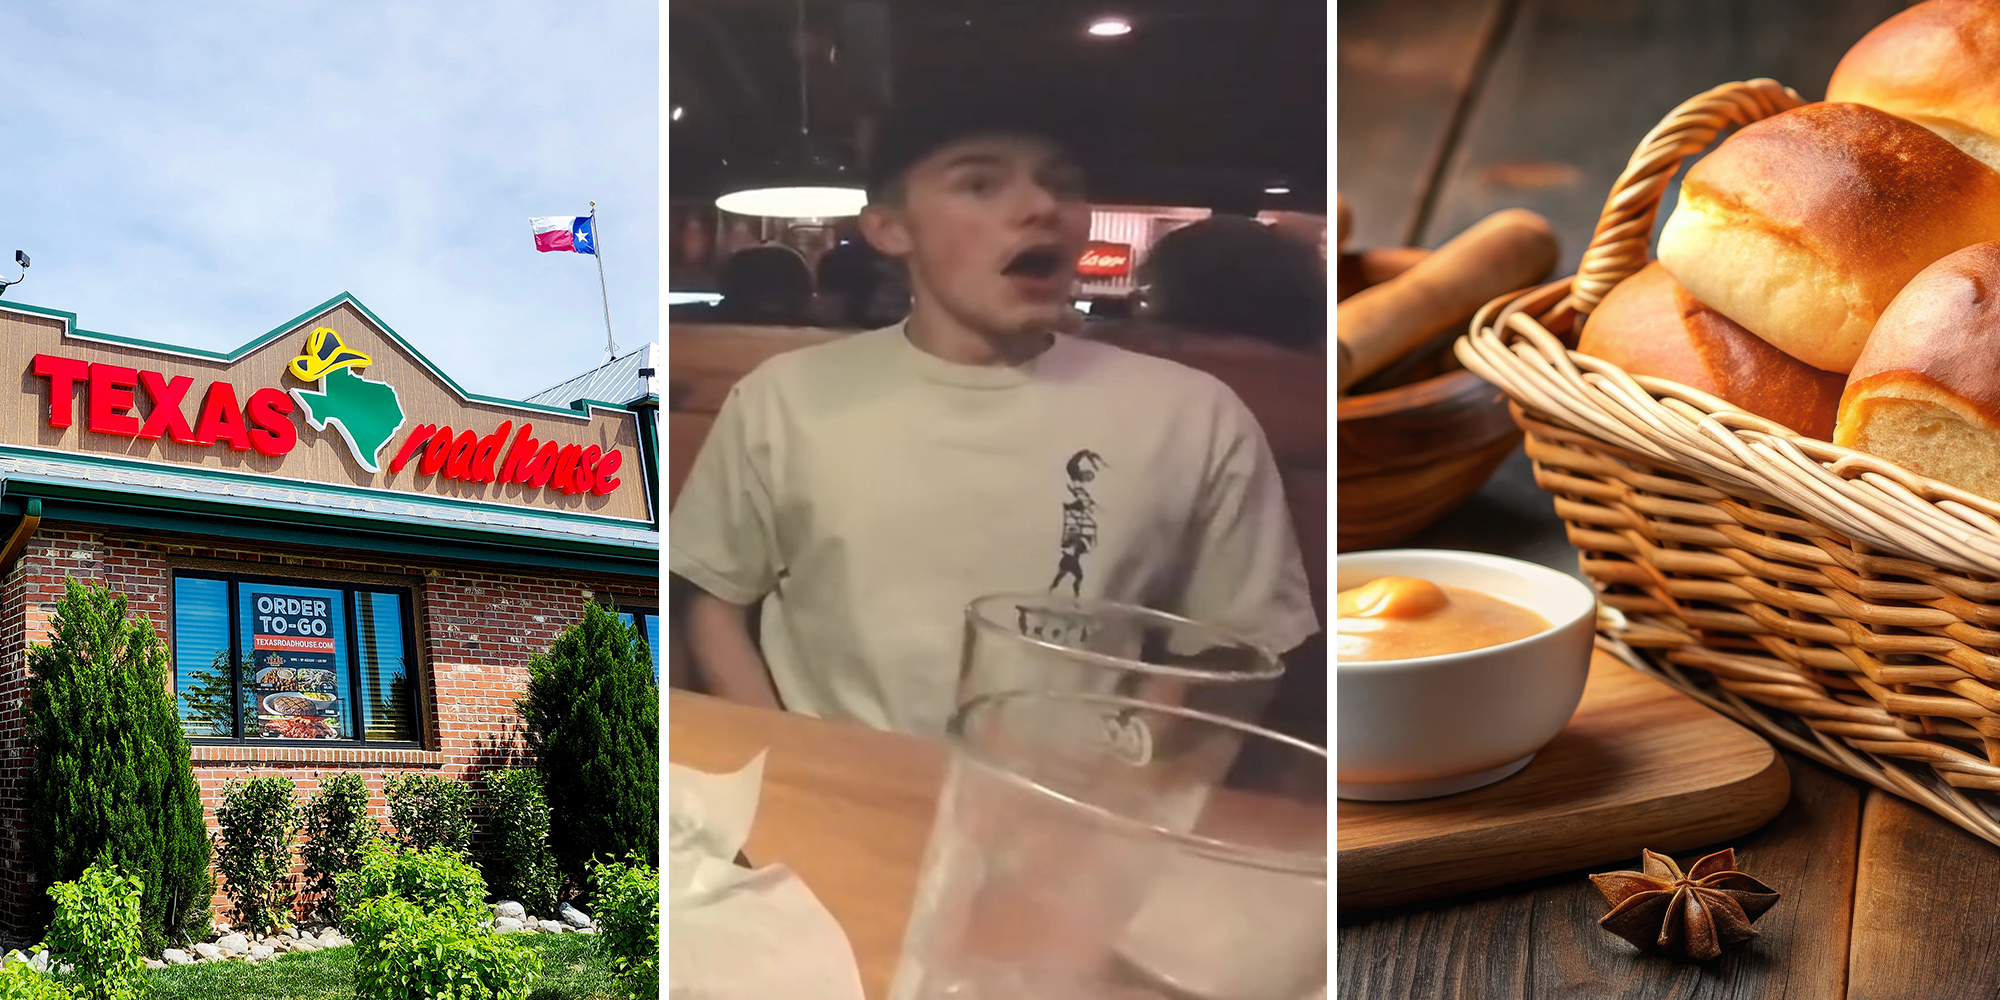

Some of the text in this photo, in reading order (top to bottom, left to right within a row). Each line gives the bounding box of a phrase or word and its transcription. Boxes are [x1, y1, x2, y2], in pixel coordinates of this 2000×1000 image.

[33, 353, 298, 457] TEXAS
[257, 597, 327, 617] ORDER
[259, 616, 327, 636] TO-GO
[255, 638, 334, 650] TEXASROADHOUSE.COM
